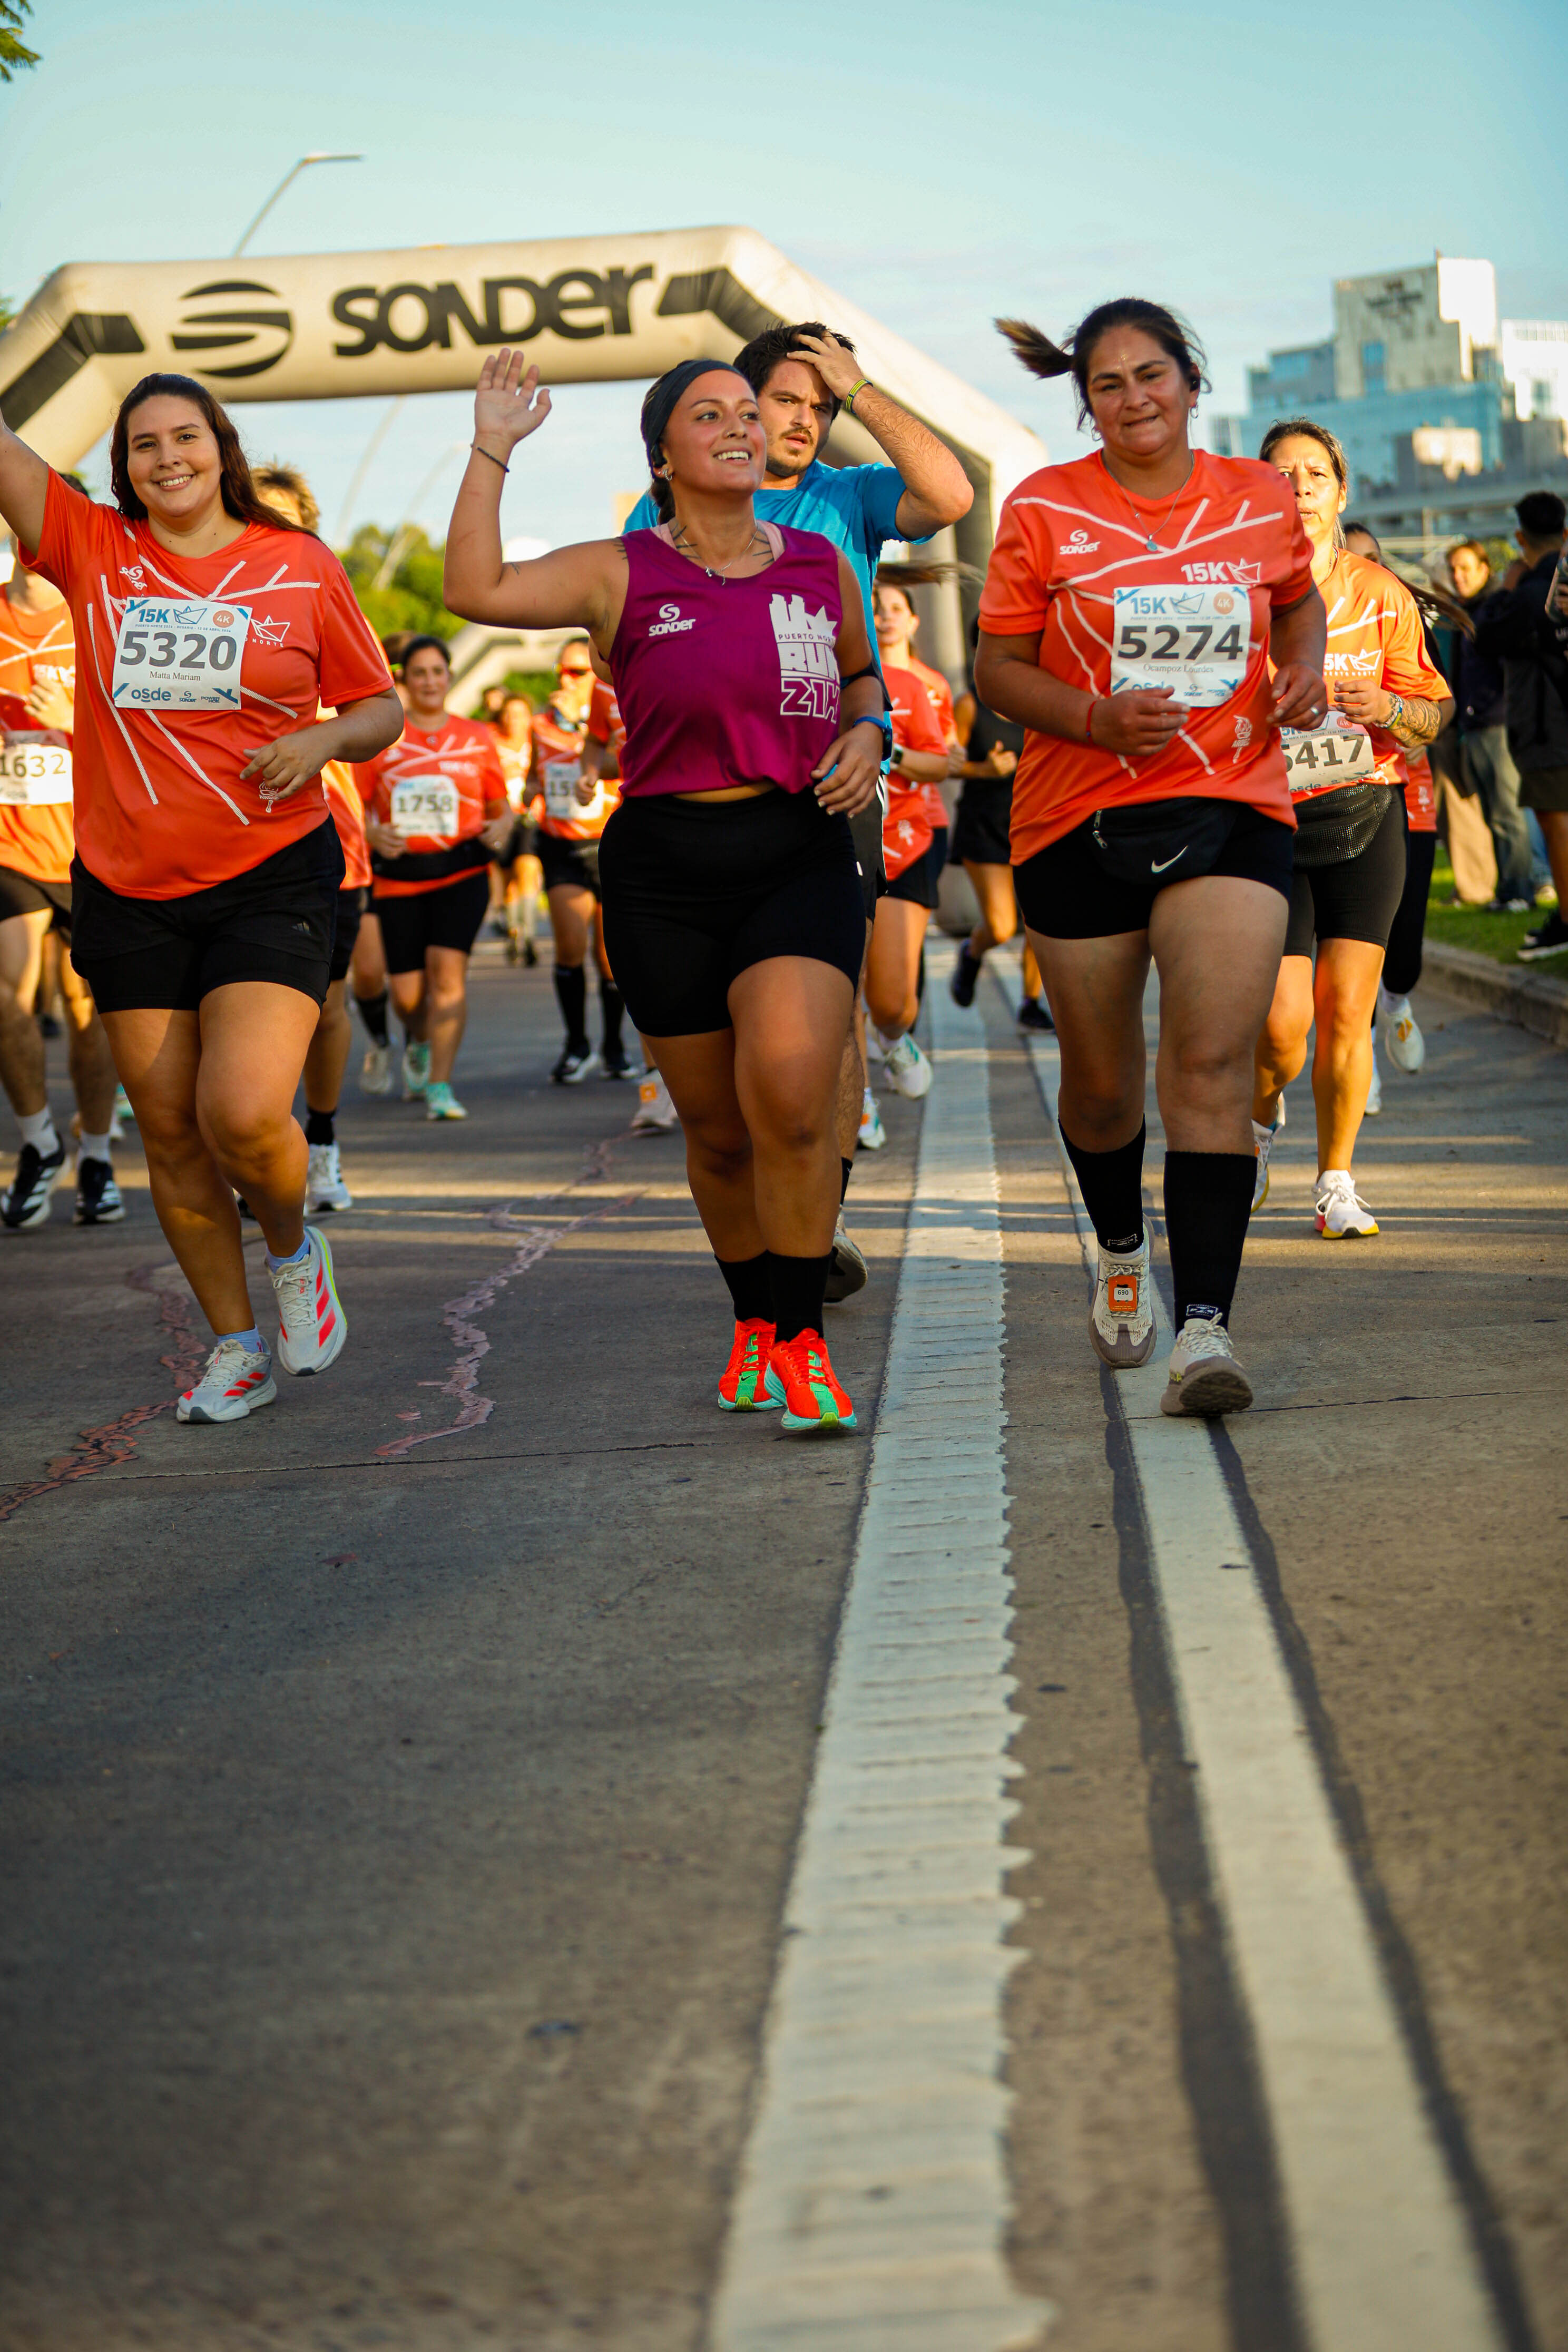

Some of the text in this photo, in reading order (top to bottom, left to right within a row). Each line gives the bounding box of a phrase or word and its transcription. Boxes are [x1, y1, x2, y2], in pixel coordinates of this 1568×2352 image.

[1181, 562, 1229, 582] 15K
[1131, 596, 1167, 614] 15K
[1217, 598, 1230, 607] 4K
[138, 609, 171, 623] 15K
[217, 615, 230, 624] 4K
[120, 631, 237, 671] 5320
[1118, 624, 1243, 660] 5274
[1143, 663, 1214, 673] Ocampoz Lourdes
[1324, 653, 1349, 671] 5K
[150, 671, 201, 681] Matta Mariam
[131, 687, 172, 702] osde
[1281, 734, 1365, 772] 5417
[0, 753, 66, 777] 1632
[399, 794, 453, 812] 1758
